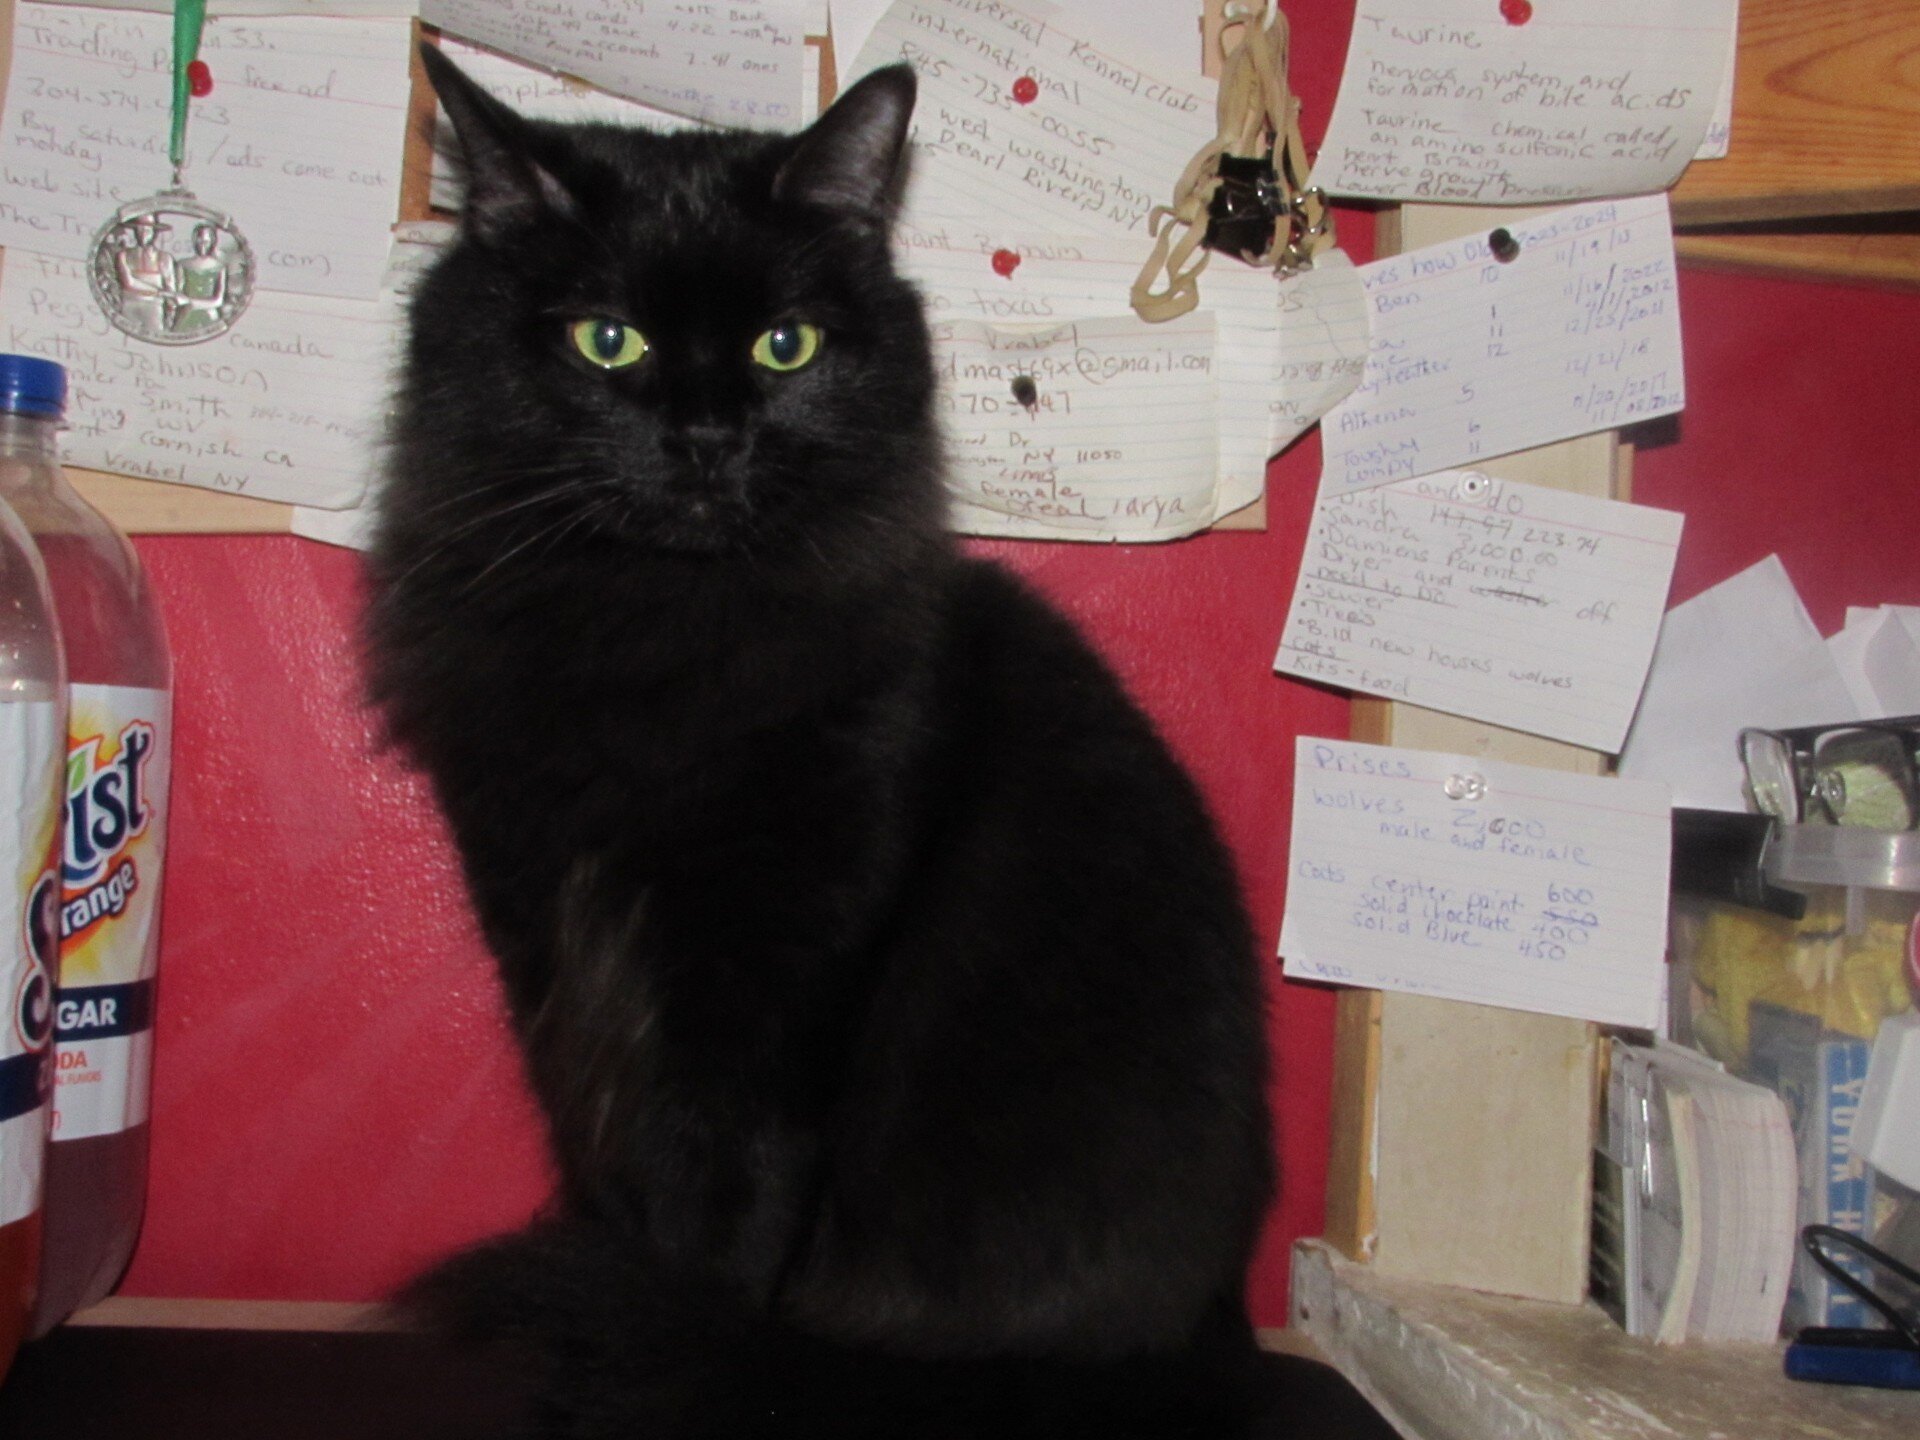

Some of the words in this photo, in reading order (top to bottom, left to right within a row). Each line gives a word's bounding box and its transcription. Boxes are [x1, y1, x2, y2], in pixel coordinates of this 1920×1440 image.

[1360, 14, 1482, 50] Taurine
[1314, 744, 1411, 779] Prises
[68, 730, 150, 864] ist
[60, 860, 136, 938] range
[56, 998, 118, 1031] GAR
